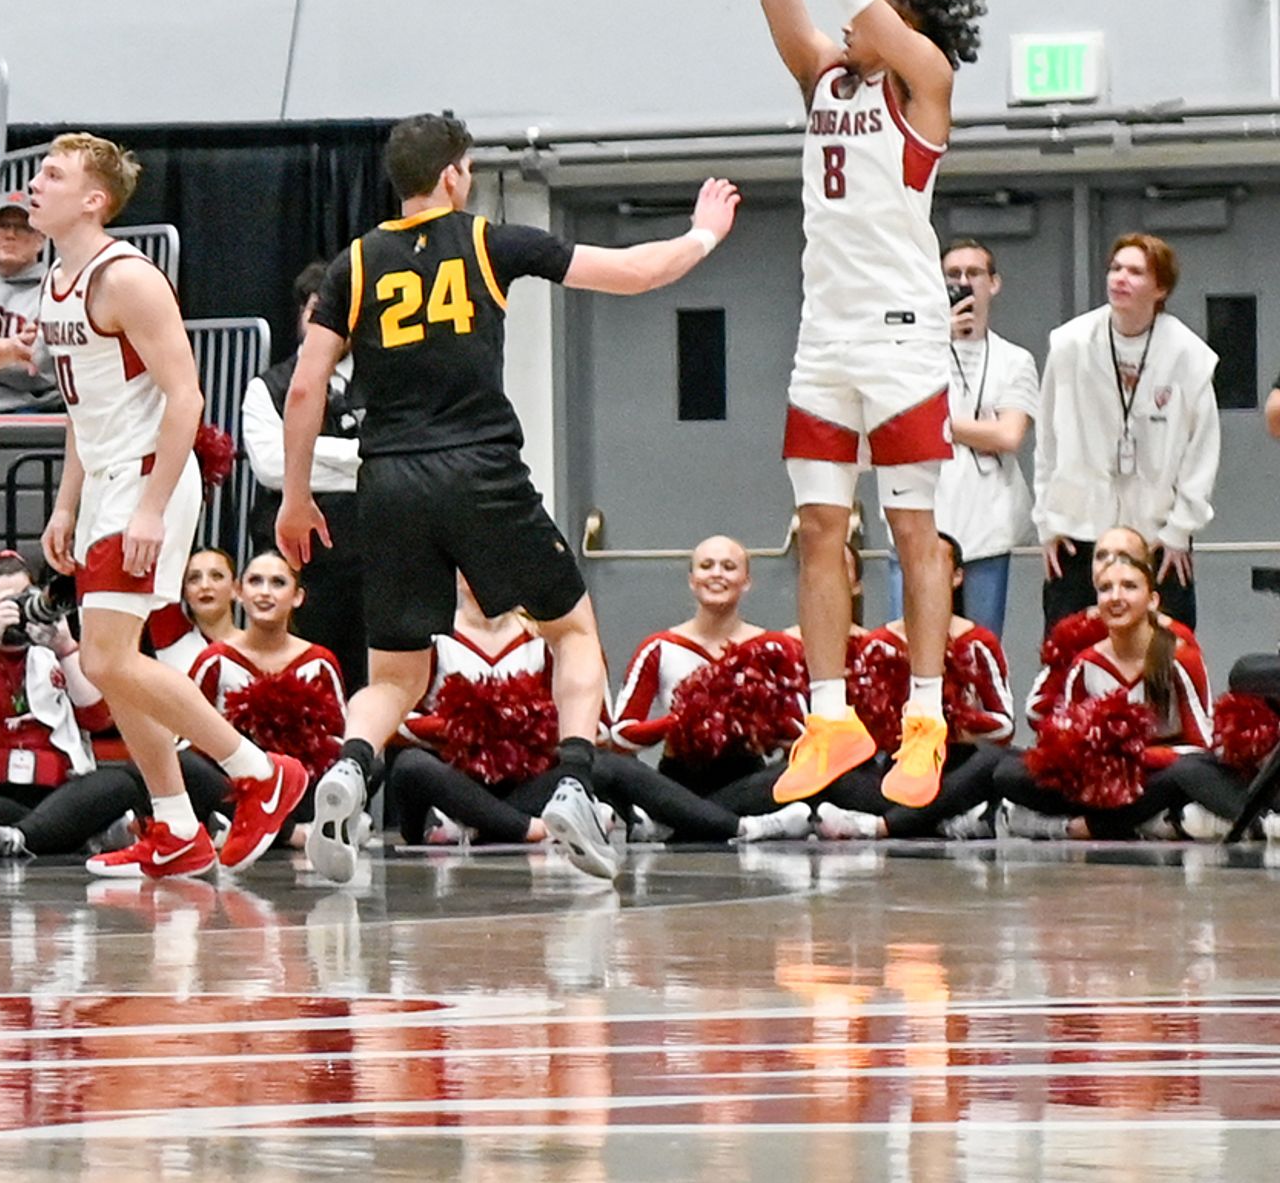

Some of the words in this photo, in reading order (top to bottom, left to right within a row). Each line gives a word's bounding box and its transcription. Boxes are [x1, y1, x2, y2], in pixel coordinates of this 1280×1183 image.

[1026, 44, 1088, 95] EXIT
[822, 145, 846, 200] 8
[376, 257, 475, 349] 24
